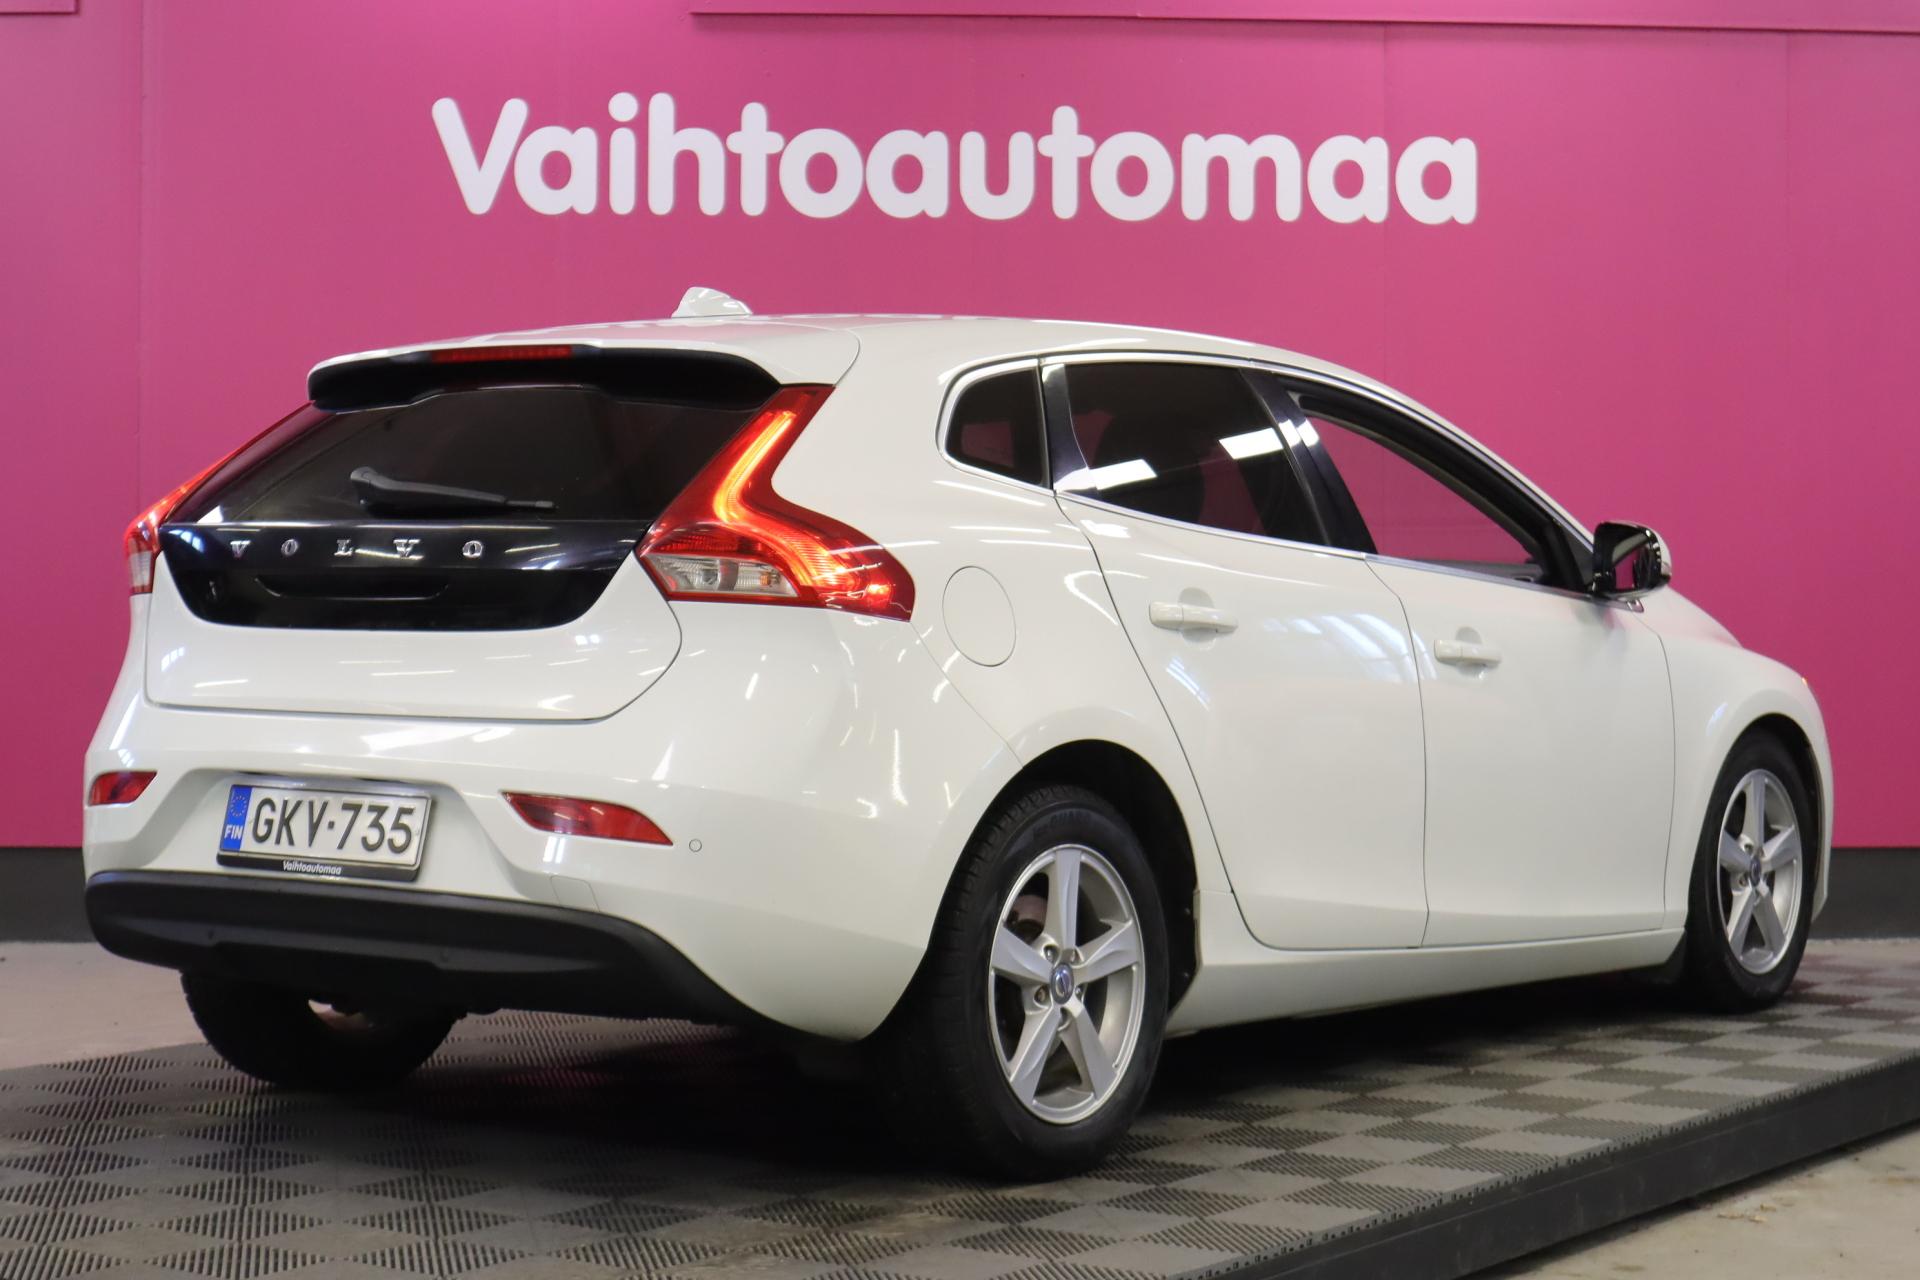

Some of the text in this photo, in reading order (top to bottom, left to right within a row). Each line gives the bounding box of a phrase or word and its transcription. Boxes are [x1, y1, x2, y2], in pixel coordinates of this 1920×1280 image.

[431, 92, 1477, 225] Vaihtoautomaa
[229, 538, 484, 560] VOLVO
[223, 824, 243, 840] FIN
[282, 860, 342, 875] Vaihtoautomaa
